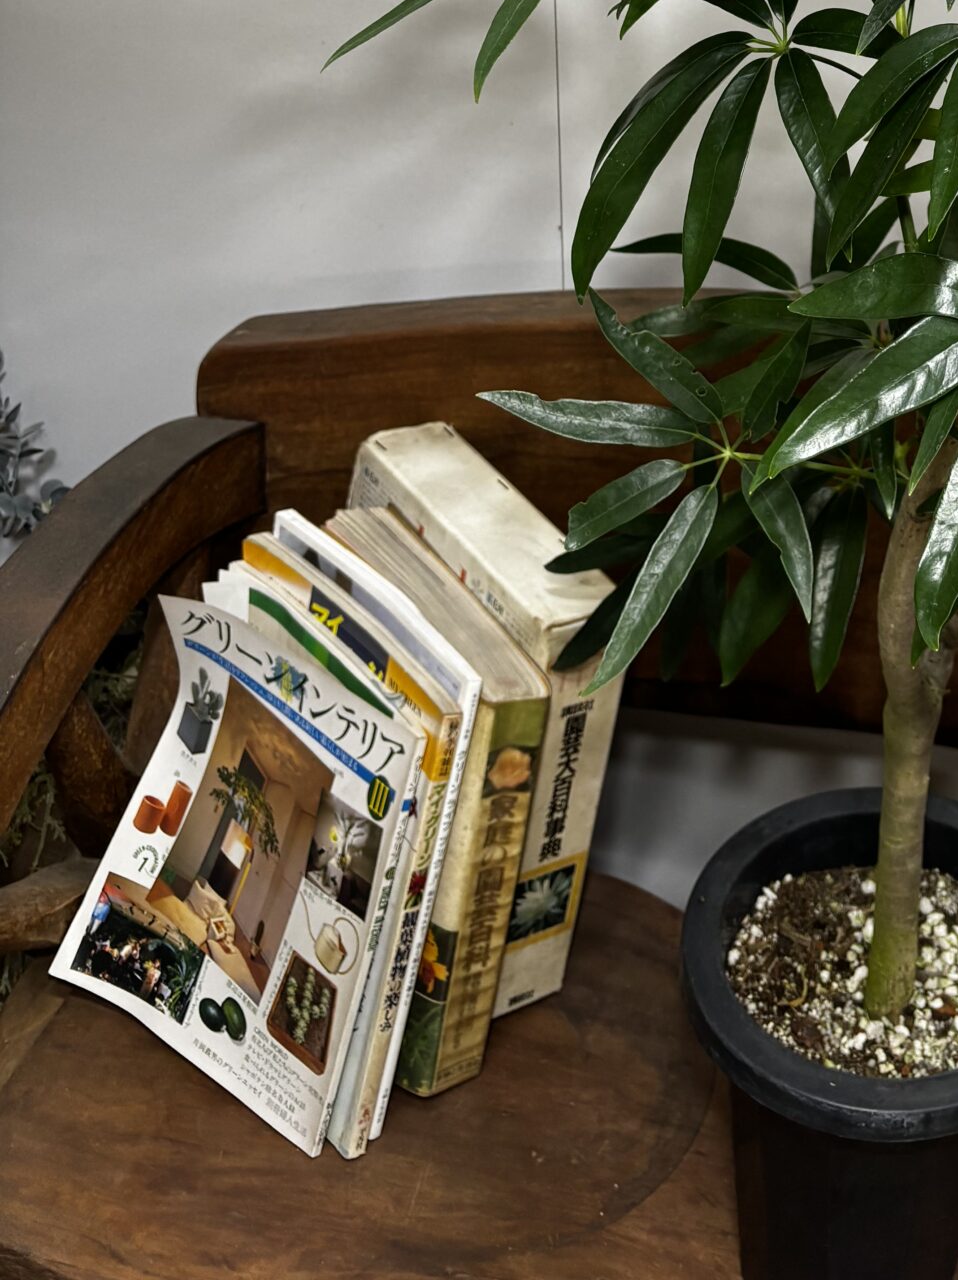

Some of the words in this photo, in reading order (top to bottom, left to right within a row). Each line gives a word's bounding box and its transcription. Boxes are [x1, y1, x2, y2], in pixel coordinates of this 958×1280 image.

[181, 610, 405, 773] グリーンインテリア
